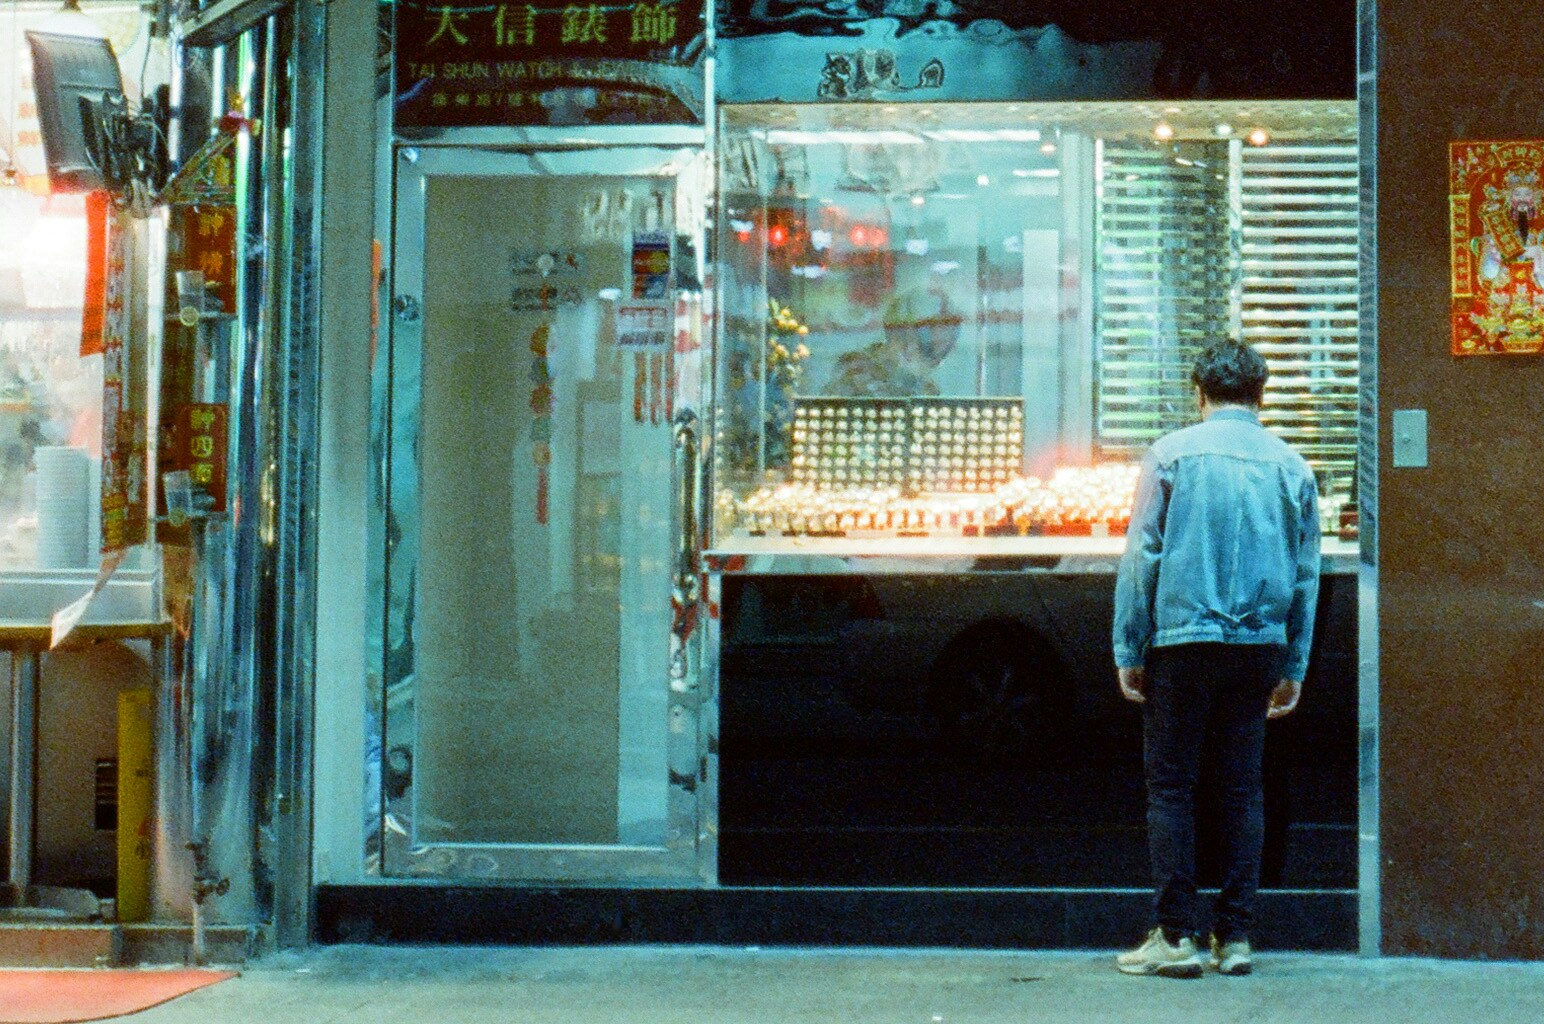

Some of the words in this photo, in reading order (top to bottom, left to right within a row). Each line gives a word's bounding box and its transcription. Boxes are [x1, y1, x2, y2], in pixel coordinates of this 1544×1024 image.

[424, 3, 676, 47] 大信錶飾
[409, 63, 434, 78] TAI
[443, 62, 489, 78] SHUN
[497, 62, 562, 78] WATCH
